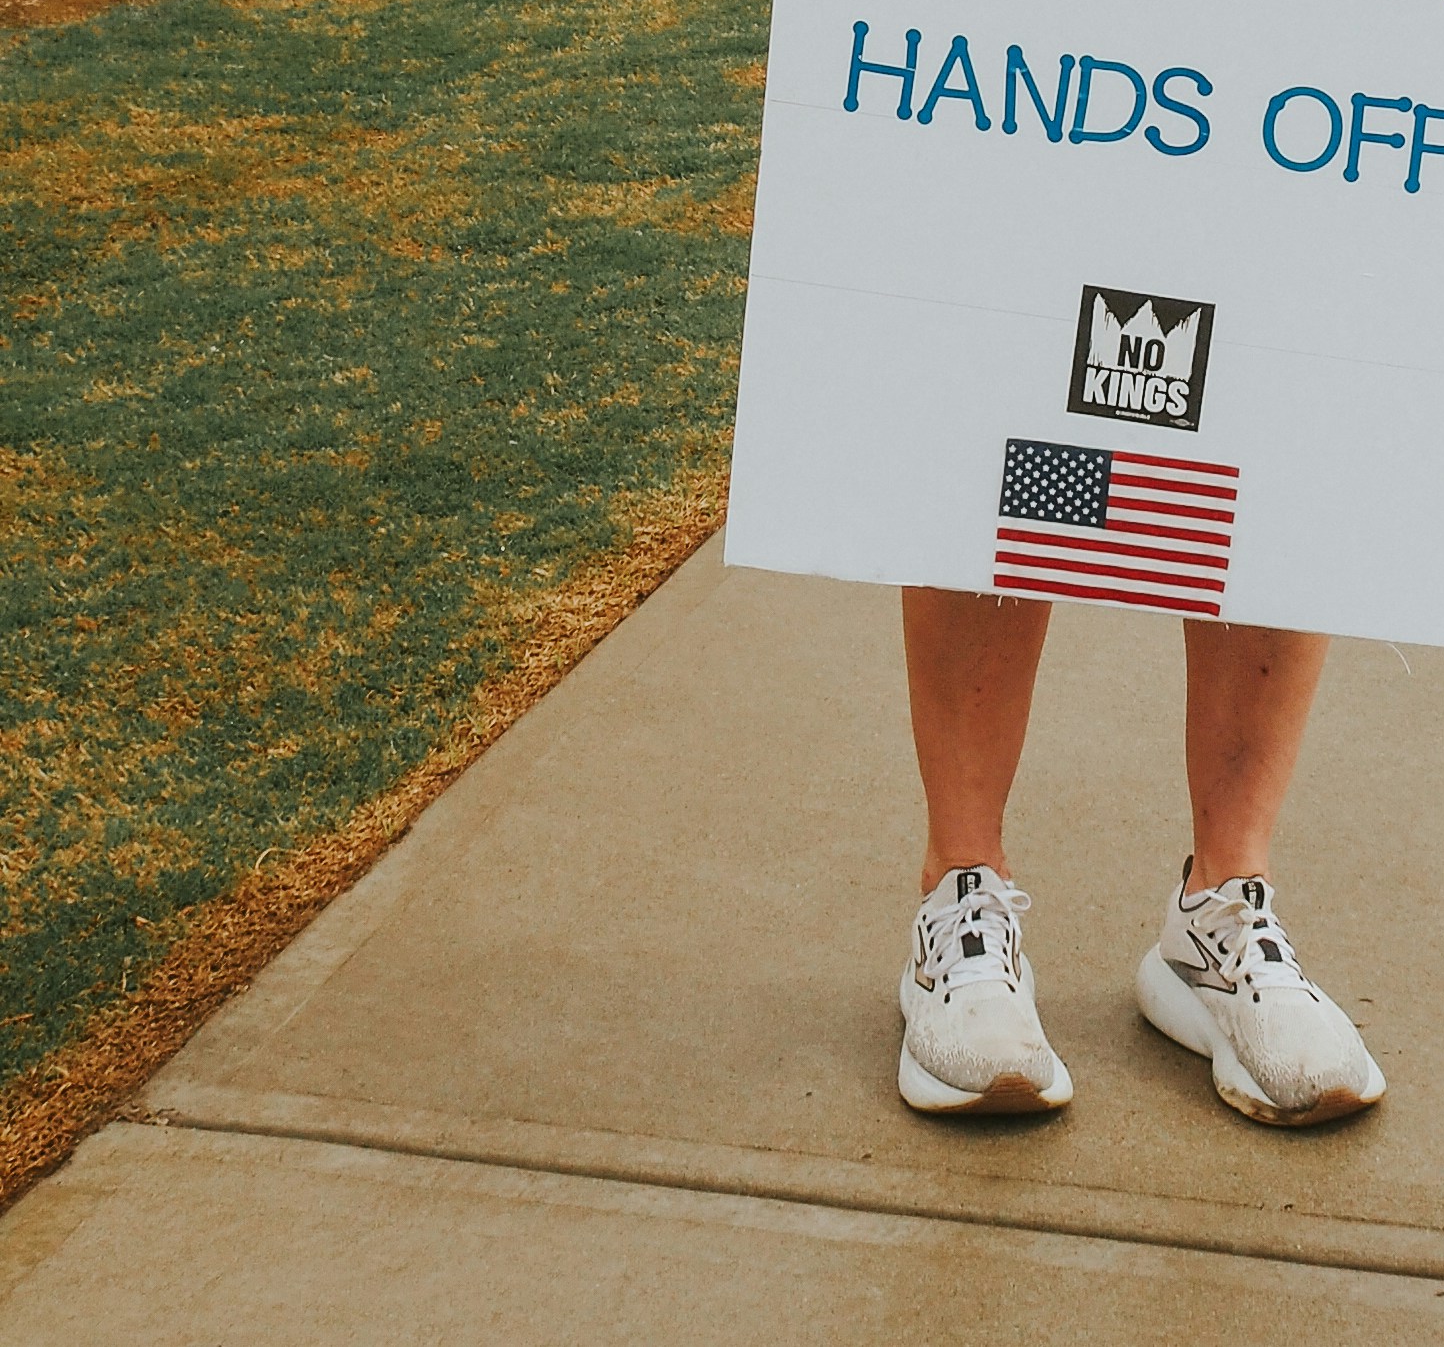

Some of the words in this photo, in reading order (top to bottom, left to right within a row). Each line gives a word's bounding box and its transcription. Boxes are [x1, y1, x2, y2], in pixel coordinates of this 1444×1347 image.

[842, 20, 1214, 157] HANDS
[1117, 333, 1166, 372] NO
[1082, 366, 1190, 417] KINGS
